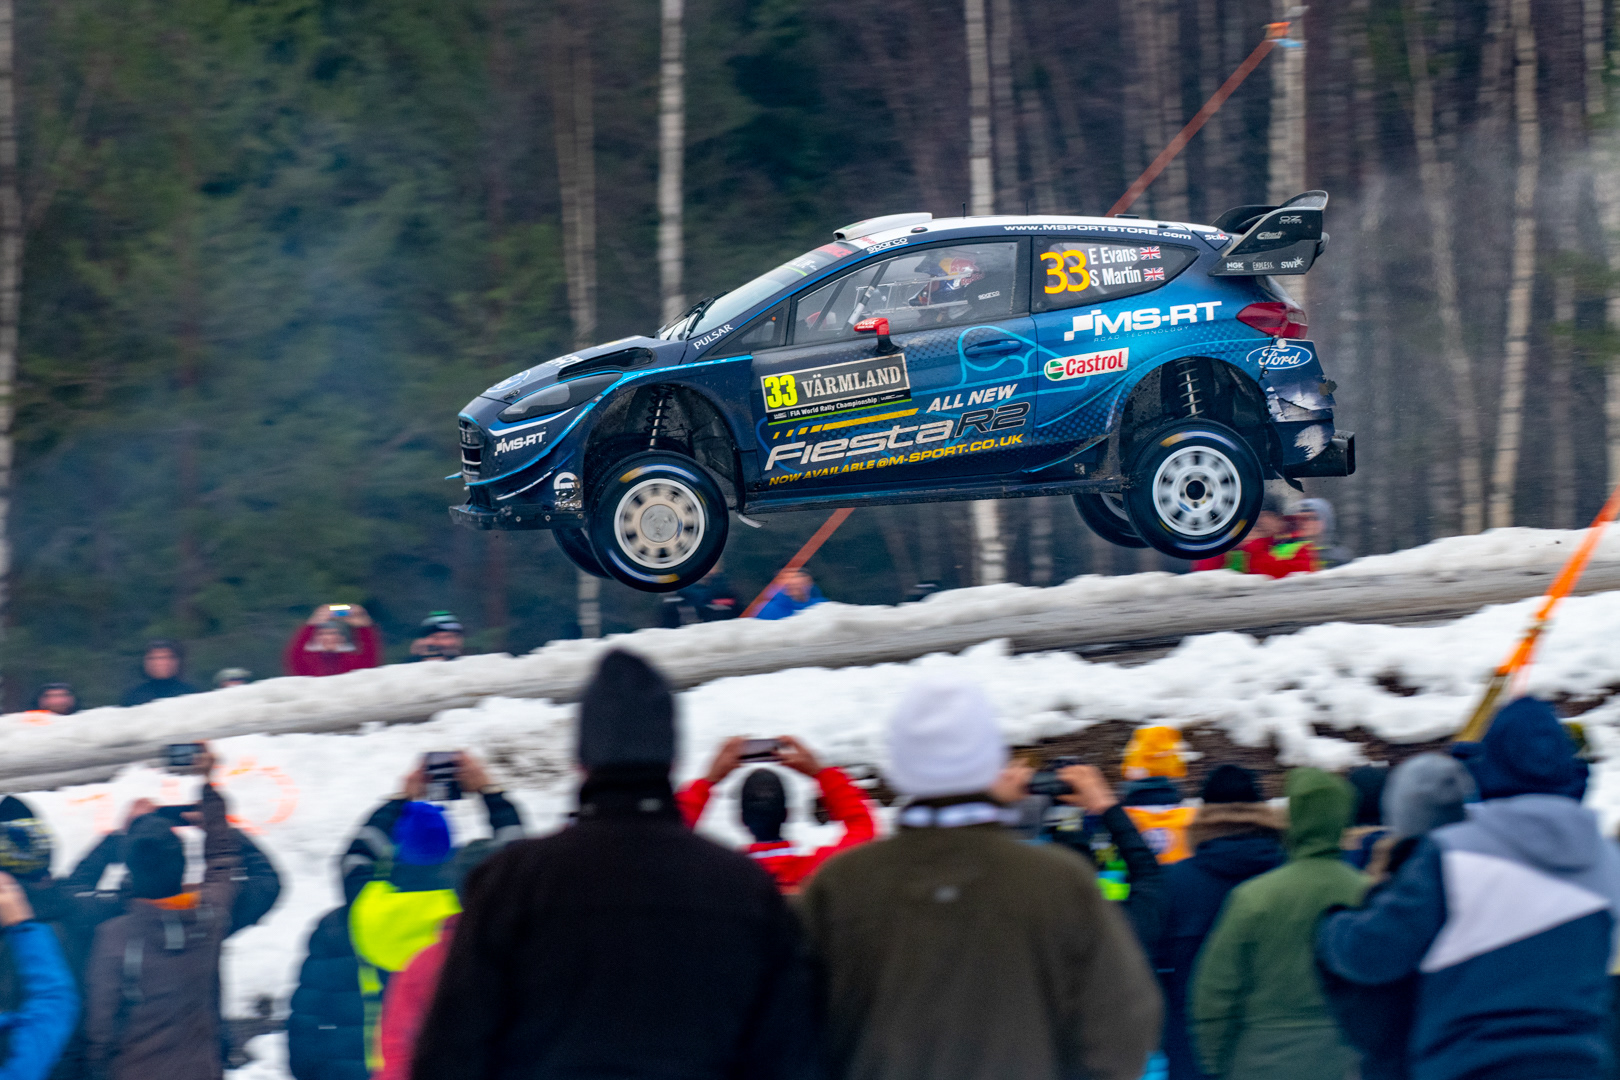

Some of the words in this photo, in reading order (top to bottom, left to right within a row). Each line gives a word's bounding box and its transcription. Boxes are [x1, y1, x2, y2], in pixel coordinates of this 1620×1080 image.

[1004, 225, 1191, 240] www.MSPORTSTORE.com
[1204, 233, 1229, 241] Stilo
[866, 237, 909, 255] sparco
[1088, 248, 1099, 265] E
[1100, 247, 1138, 265] Evans
[1040, 249, 1091, 294] 33
[1089, 269, 1100, 287] S
[1102, 266, 1142, 286] Martin
[1094, 301, 1223, 336] MS-RT
[693, 323, 734, 351] PULSAR
[1065, 351, 1125, 377] Castrol
[1258, 347, 1302, 367] Ford
[763, 374, 799, 409] 33
[801, 365, 901, 399] VÄRMLAND
[926, 393, 964, 414] ALL
[963, 383, 1019, 407] NEW
[790, 408, 801, 417] FIA
[801, 405, 819, 416] World
[820, 402, 835, 413] Rally
[836, 396, 878, 410] Championship
[954, 401, 1032, 439] R2
[503, 431, 547, 453] MS-RT
[769, 472, 802, 487] NOW
[801, 459, 875, 480] AVAILABLE
